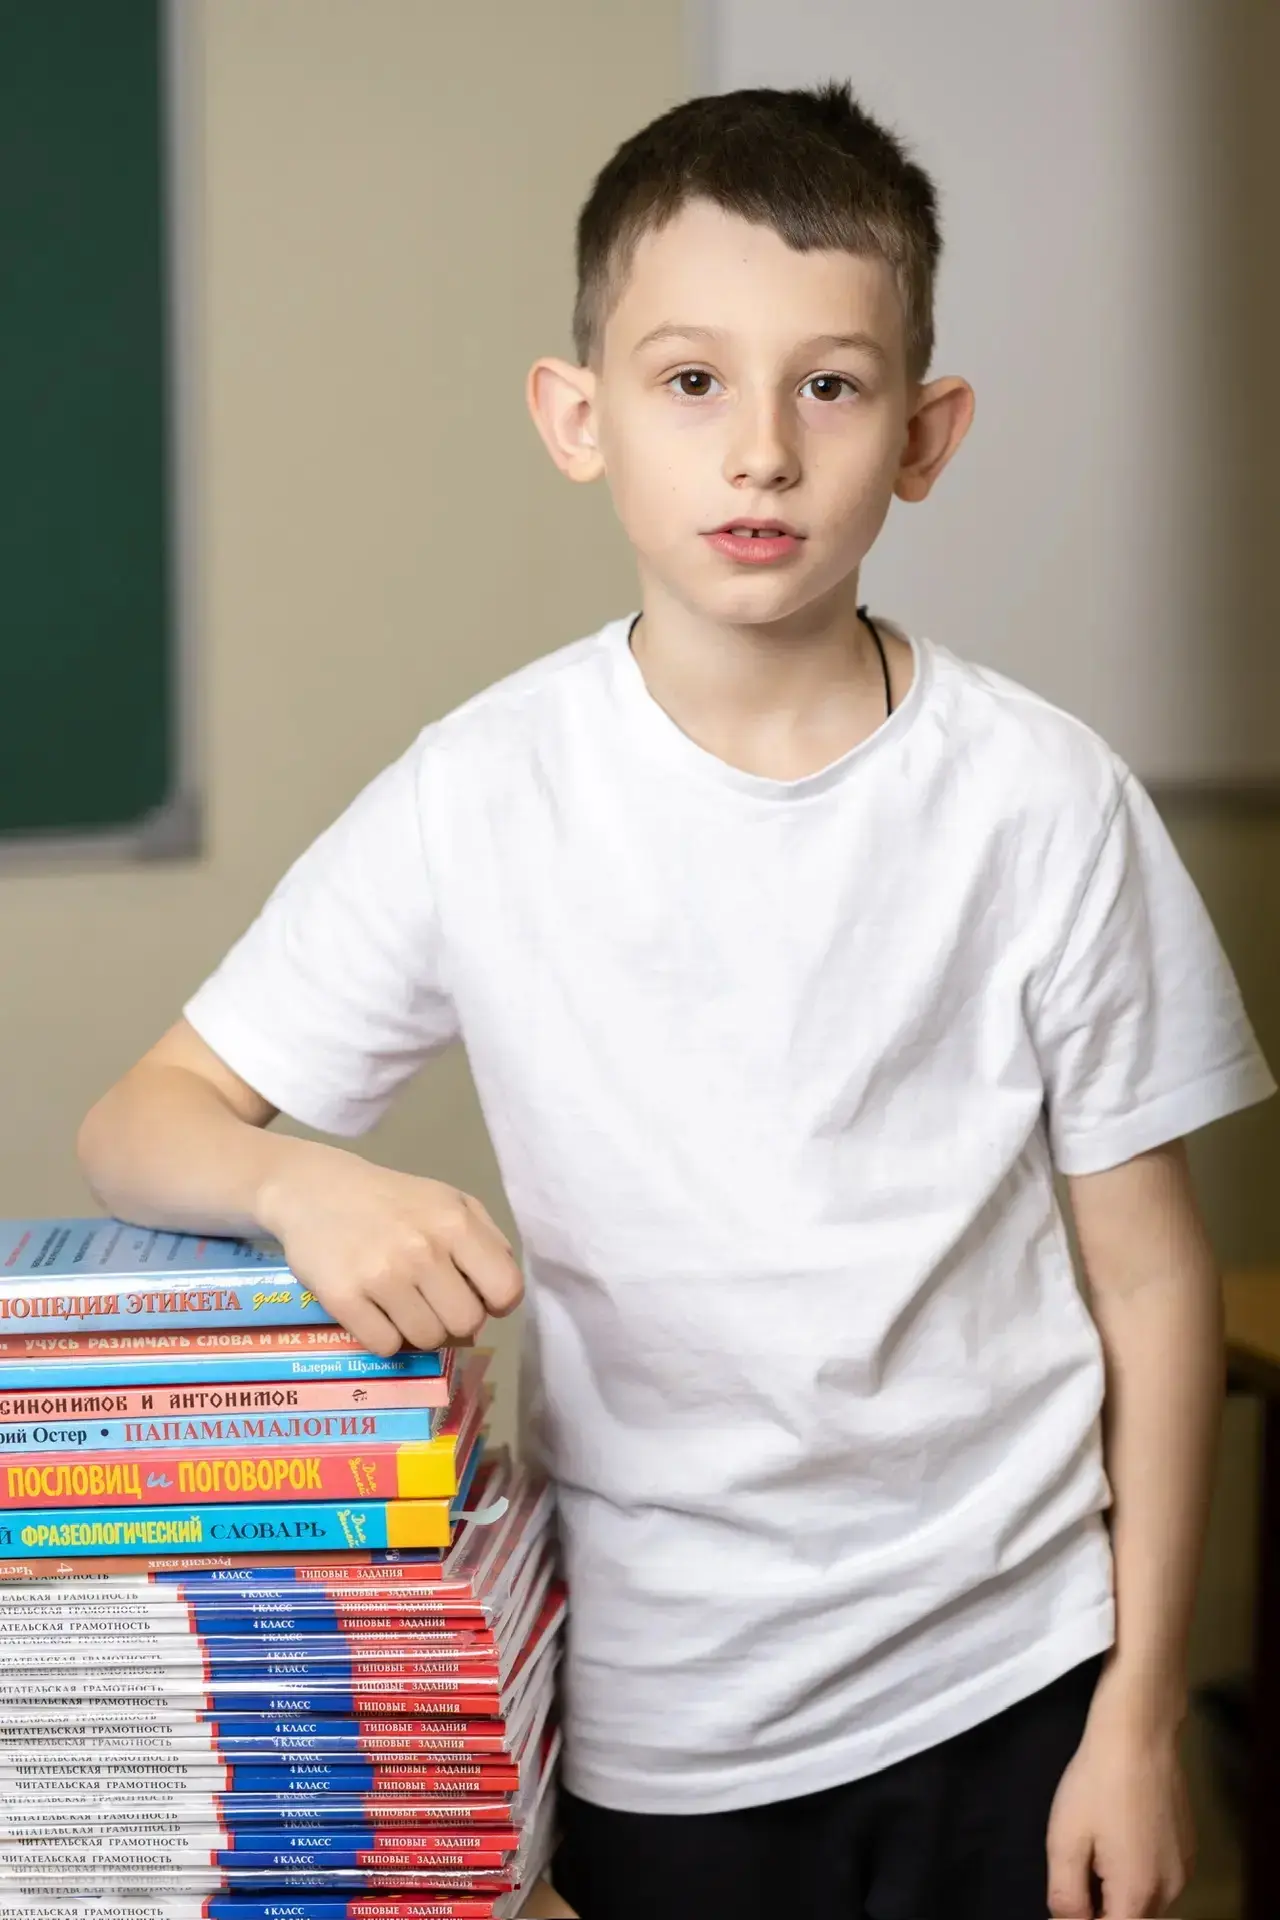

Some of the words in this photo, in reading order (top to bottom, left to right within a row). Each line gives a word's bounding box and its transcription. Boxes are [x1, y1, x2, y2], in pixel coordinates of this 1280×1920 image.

[126, 1290, 243, 1314] ЭТИКЕТА
[253, 1292, 292, 1311] для
[25, 1338, 80, 1350] УЧУСЬ
[88, 1336, 190, 1349] РАЗЛИЧАТЬ
[197, 1334, 253, 1347] СЛОВА
[260, 1334, 272, 1346] И
[278, 1333, 302, 1345] ИХ
[292, 1360, 342, 1374] Валерий
[348, 1359, 405, 1374] Шульжик
[0, 1396, 127, 1415] СИНОНИМОВ
[142, 1395, 153, 1409] И
[169, 1390, 298, 1409] АНТОНИМОВ
[33, 1427, 87, 1445] Остер
[124, 1416, 377, 1442] ПАПАМАМАЛОГИЯ
[7, 1464, 142, 1499] ПОСЛОВИЦ
[147, 1472, 173, 1488] и
[178, 1458, 323, 1492] ПОГОВОРОК
[21, 1516, 202, 1547] ФРАЗЕОЛОГИЧЕСКИЙ
[210, 1522, 327, 1540] СЛОВАРЬ
[148, 1558, 178, 1568] язык
[181, 1556, 232, 1567] Русский
[57, 1563, 73, 1574] 4
[211, 1571, 217, 1580] 4
[219, 1571, 253, 1580] КЛАСС
[301, 1570, 349, 1579] ТИПОВЫЕ
[357, 1569, 403, 1578] ЗАДАНИЯ
[0, 1623, 63, 1632] АТЕЛЬСКАЯ
[70, 1622, 151, 1631] ГРАМОТНОСТЬ
[253, 1620, 259, 1628] 4
[260, 1620, 295, 1628] КЛАСС
[343, 1619, 392, 1628] ТИПОВЫЕ
[399, 1618, 446, 1628] ЗАДАНИЯ
[275, 1664, 309, 1673] КЛАСС
[358, 1663, 405, 1672] ТИПОВЫЕ
[413, 1663, 460, 1672] ЗАДАНИЯ
[83, 1684, 164, 1692] ГРАМОТНОСТЬ
[89, 1698, 168, 1706] ГРАМОТНОСТЬ
[270, 1701, 276, 1709] 4
[277, 1701, 311, 1709] КЛАСС
[358, 1702, 406, 1711] ТИПОВЫЕ
[414, 1703, 460, 1713] ЗАДАНИЯ
[1, 1727, 86, 1735] ЧИТАТЕЛЬСКАЯ
[93, 1725, 173, 1734] ГРАМОТНОСТЬ
[282, 1724, 317, 1732] КЛАСС
[365, 1723, 413, 1732] ТИПОВЫЕ
[421, 1723, 467, 1732] ЗАДАНИЯ
[93, 1738, 172, 1747] ГРАМОТНОСТЬ
[363, 1739, 411, 1748] ТИПОВЫЕ
[419, 1739, 465, 1748] ЗАДАНИЯ
[16, 1766, 101, 1774] ЧИТАТЕЛЬСКАЯ
[107, 1765, 188, 1774] ГРАМОТНОСТЬ
[290, 1765, 296, 1773] 4
[297, 1765, 332, 1773] КЛАСС
[380, 1765, 428, 1774] ТИПОВЫЕ
[435, 1765, 481, 1774] ЗАДАНИЯ
[15, 1781, 100, 1789] ЧИТАТЕЛЬСКАЯ
[107, 1780, 187, 1789] ГРАМОТНОСТЬ
[296, 1781, 331, 1789] КЛАСС
[378, 1781, 427, 1790] ТИПОВЫЕ
[434, 1781, 480, 1791] ЗАДАНИЯ
[370, 1809, 418, 1817] ТИПОВЫЕ
[425, 1809, 471, 1818] ЗАДАНИЯ
[18, 1838, 103, 1847] ЧИТАТЕЛЬСКАЯ
[109, 1838, 189, 1847] ГРАМОТНОСТЬ
[290, 1838, 296, 1846] 4
[298, 1838, 332, 1846] КЛАСС
[379, 1838, 428, 1847] ТИПОВЫЕ
[435, 1838, 481, 1848] ЗАДАНИЯ
[2, 1855, 86, 1863] ЧИТАТЕЛЬСКАЯ
[93, 1855, 172, 1863] ГРАМОТНОСТЬ
[280, 1855, 314, 1863] КЛАСС
[362, 1855, 410, 1864] ТИПОВЫЕ
[418, 1856, 464, 1865] ЗАДАНИЯ
[85, 1908, 163, 1916] ГРАМОТНОСТЬ
[264, 1907, 270, 1915] 4
[271, 1907, 305, 1915] КЛАСС
[352, 1907, 400, 1915] ТИПОВЫЕ
[407, 1906, 454, 1916] ЗАДАНИЯ
